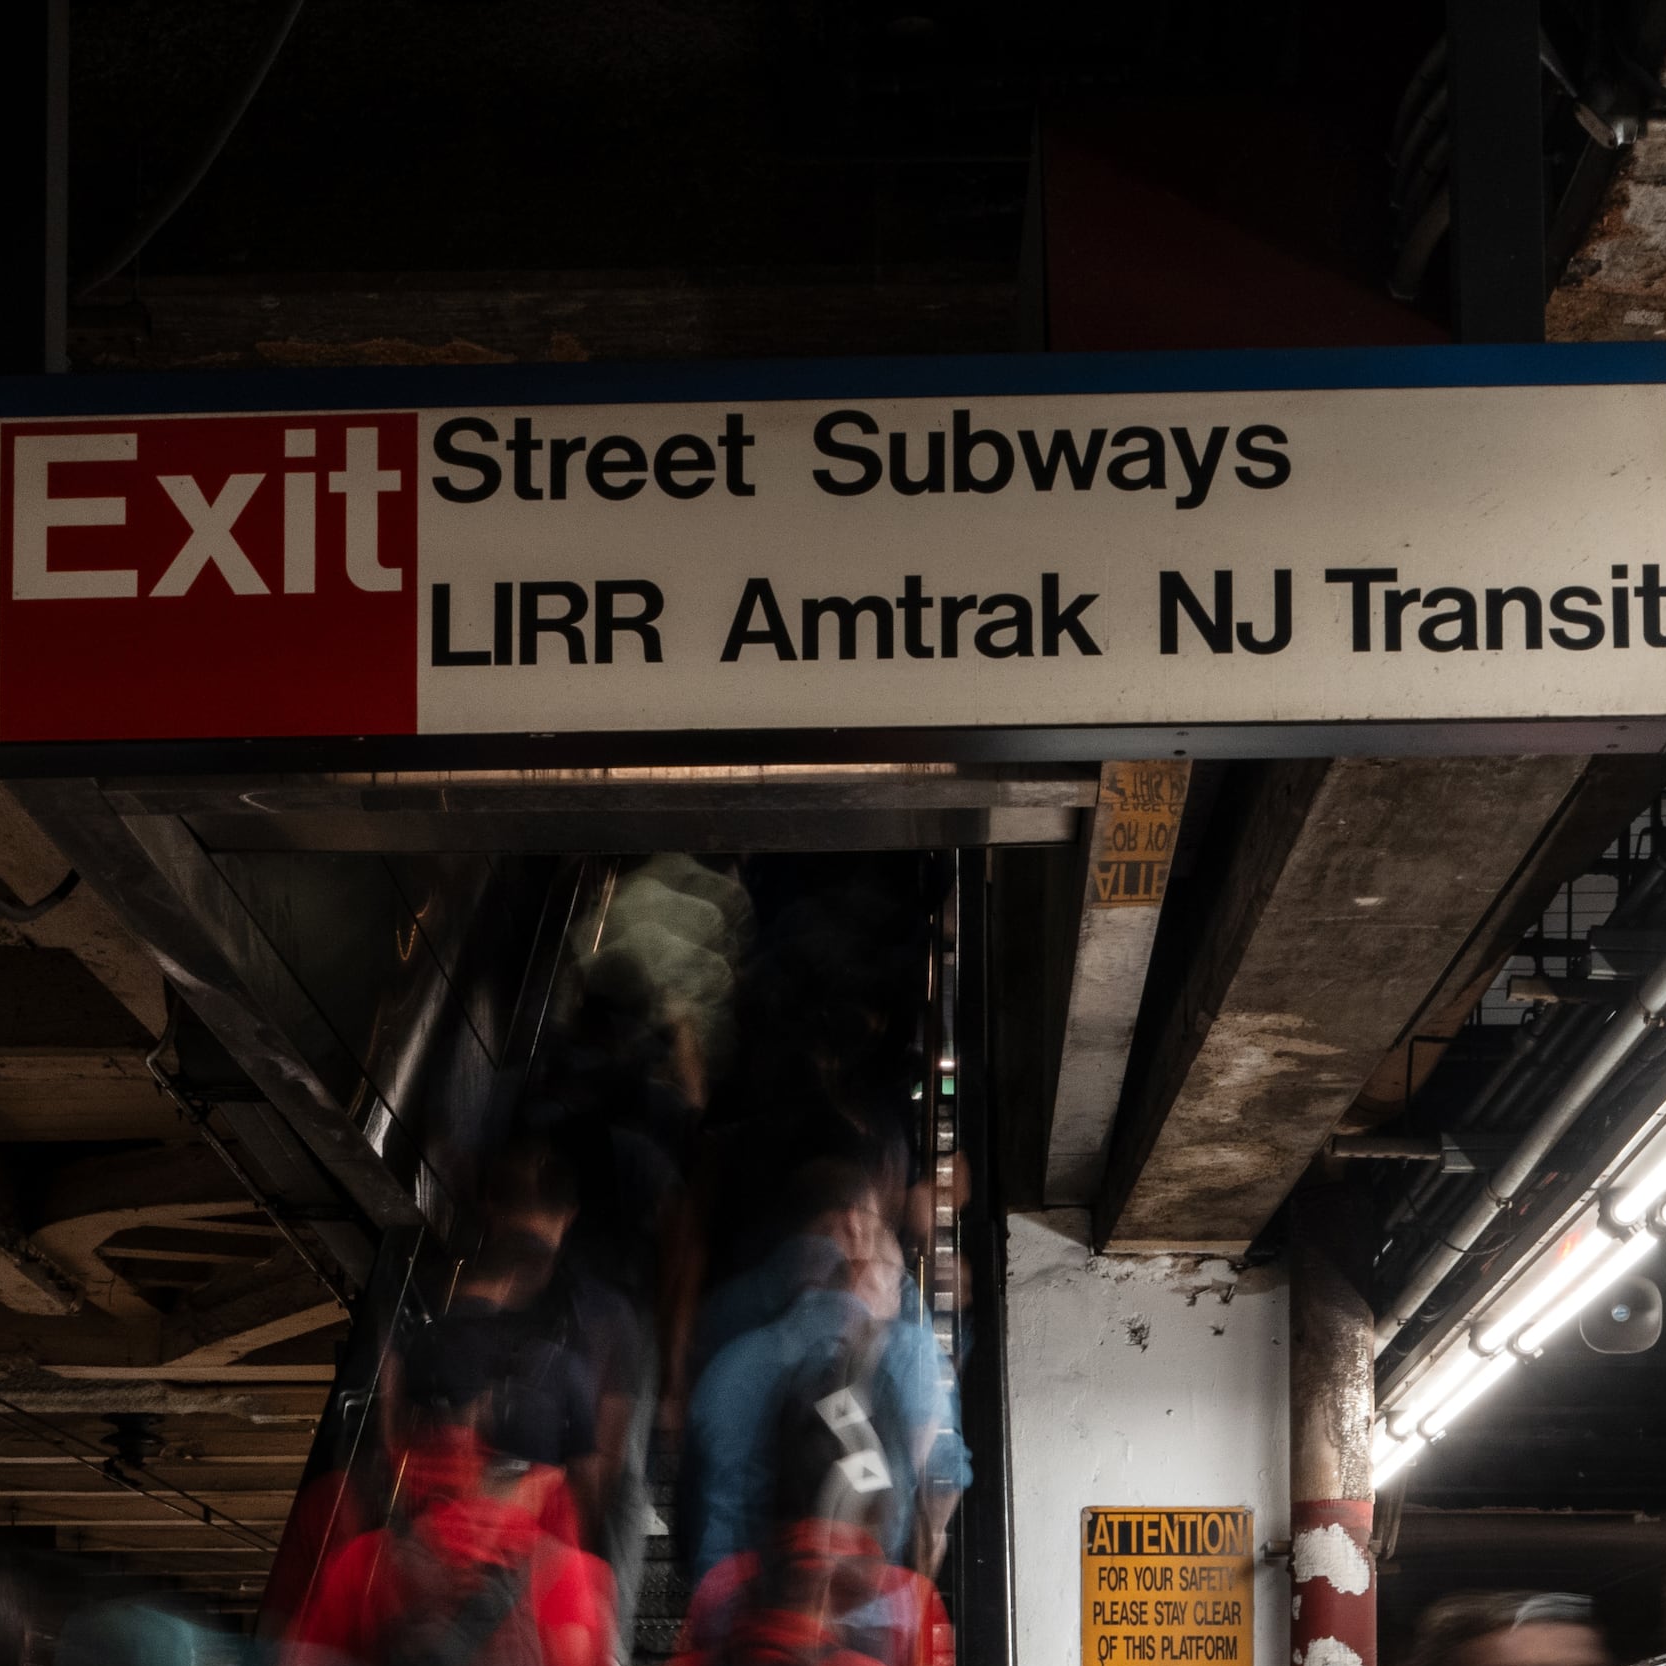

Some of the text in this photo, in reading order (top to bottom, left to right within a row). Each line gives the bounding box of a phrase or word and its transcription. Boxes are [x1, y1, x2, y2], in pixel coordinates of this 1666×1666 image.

[432, 408, 1292, 511] Street Subways
[12, 427, 402, 600] Exit
[430, 578, 665, 668] LIRR
[719, 572, 1103, 663] Amtrak
[1159, 568, 1293, 655] NJ
[1092, 1512, 1245, 1554] ATTENTION
[1098, 1566, 1128, 1591] FOR
[1134, 1566, 1173, 1591] YOUR
[1093, 1601, 1241, 1626] PLEASE STAY CLEAR
[1098, 1635, 1238, 1660] OF THIS PLATFORM
